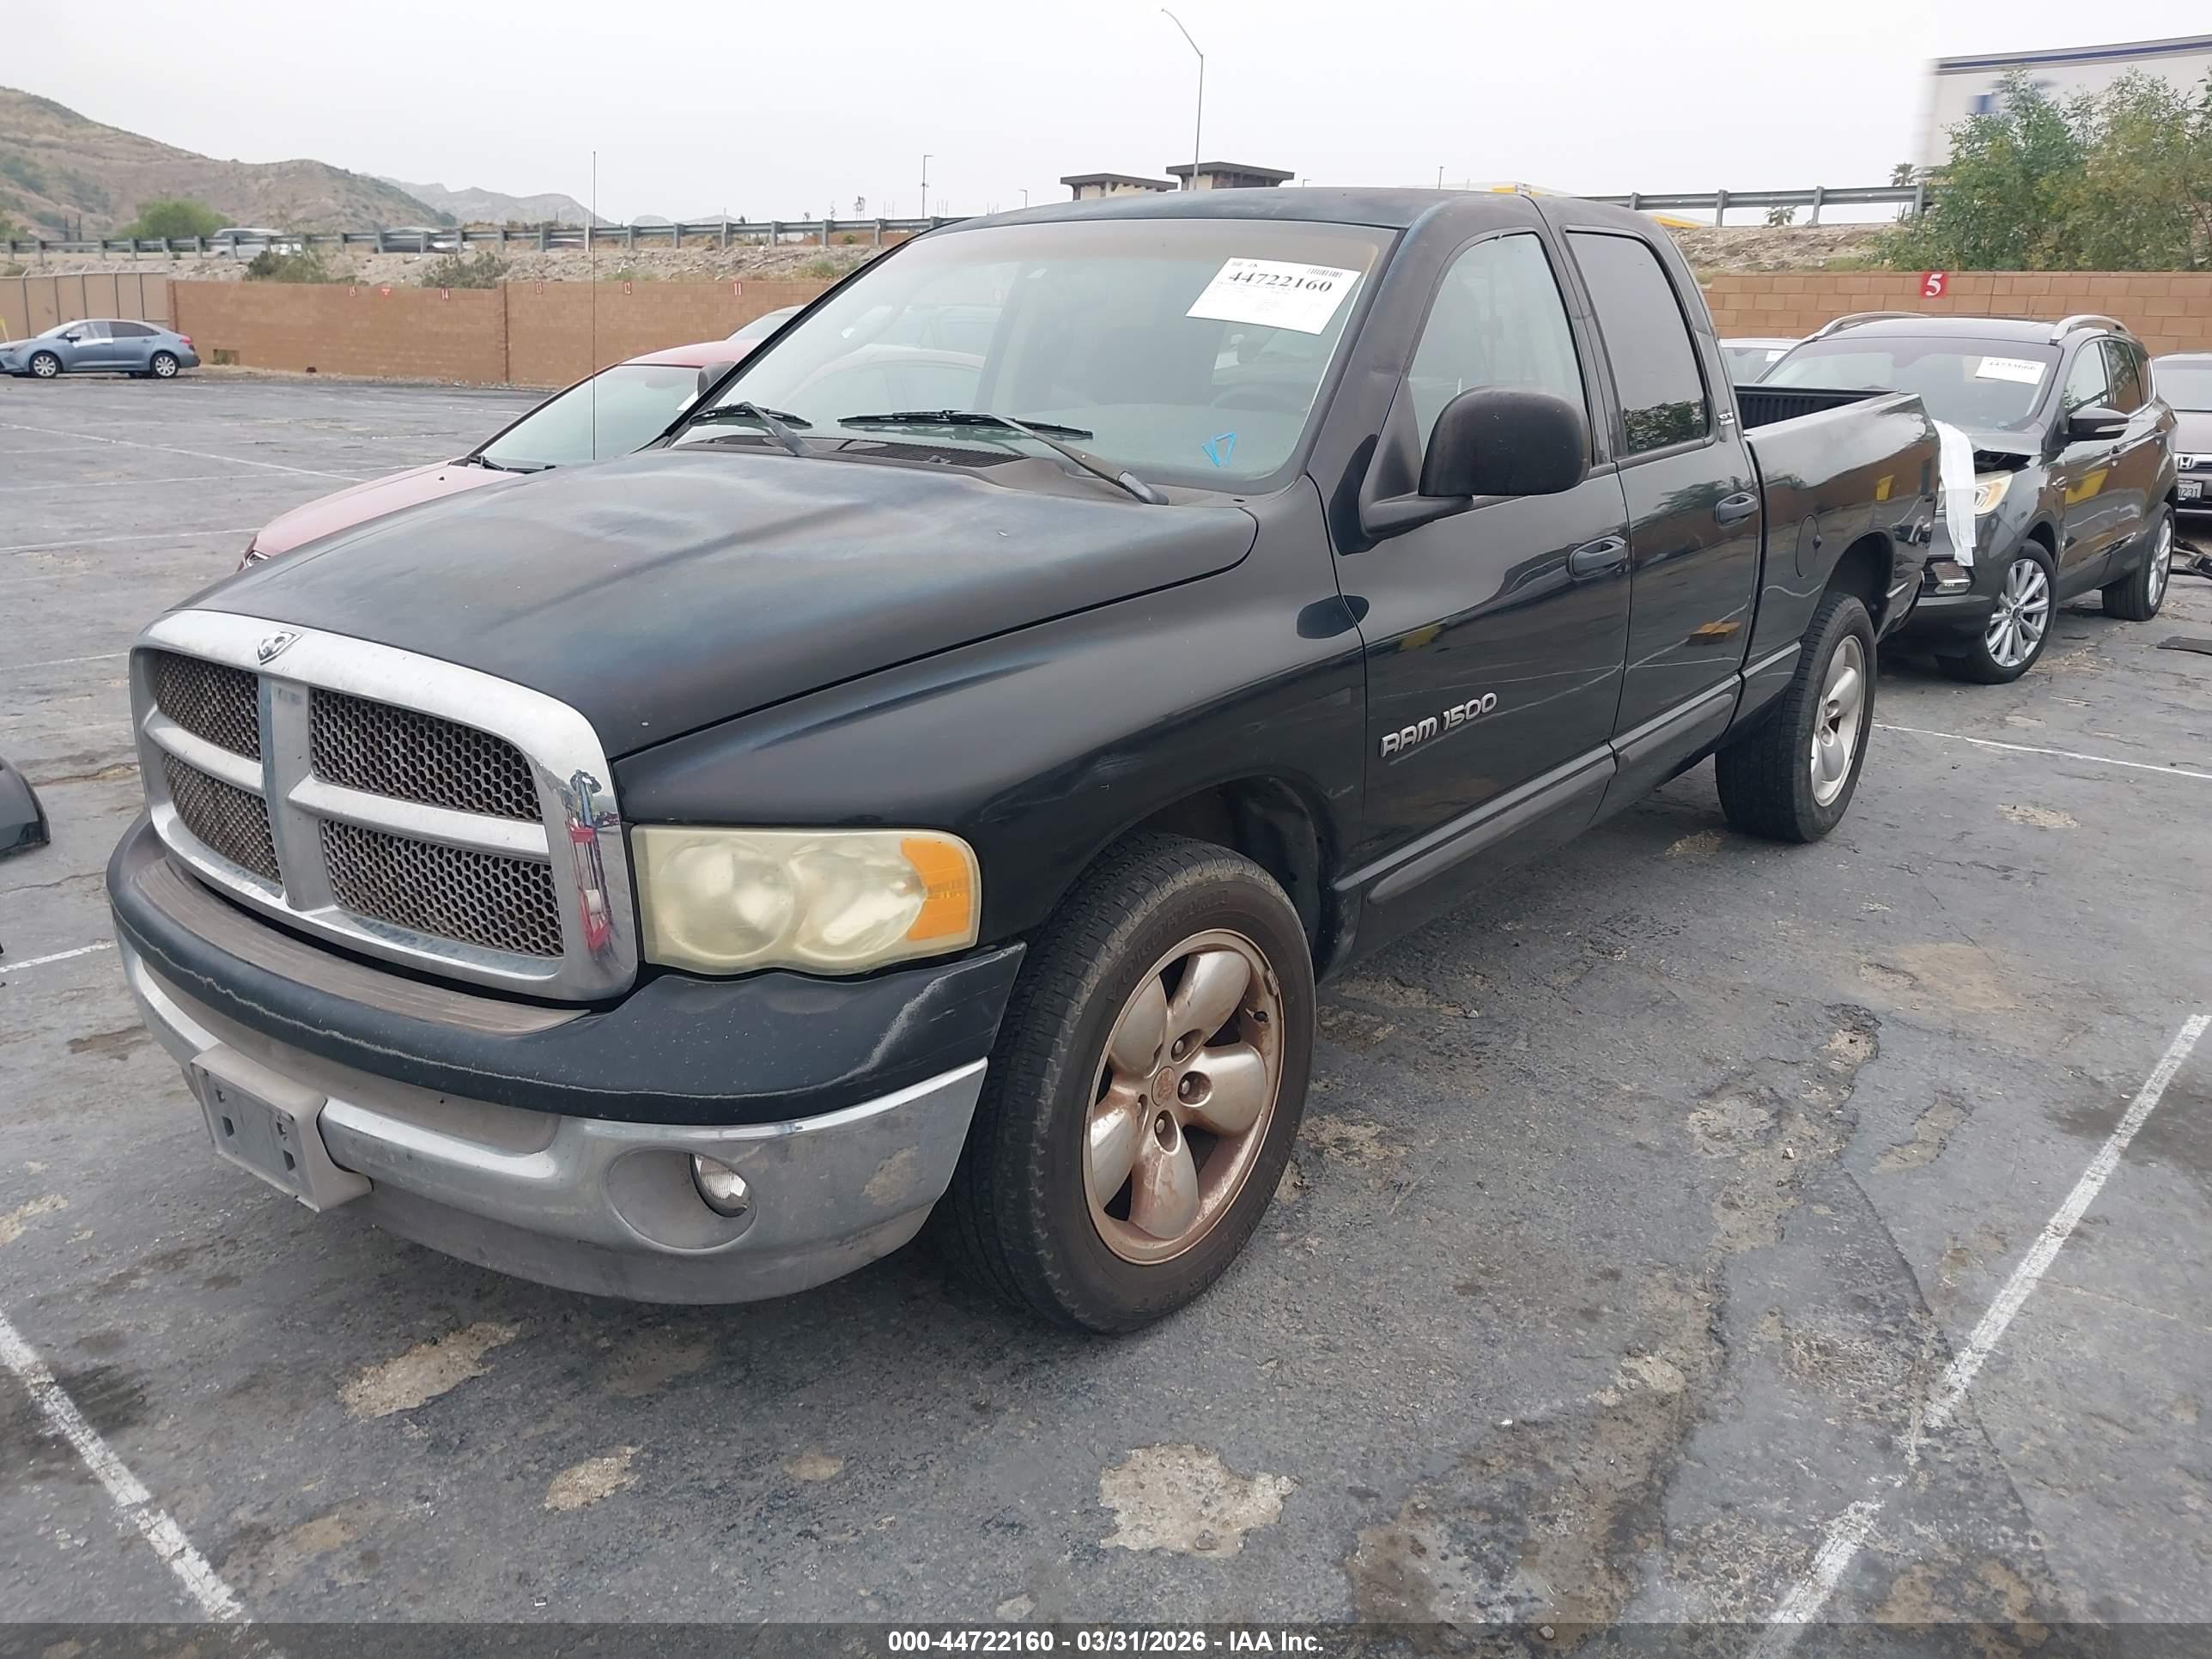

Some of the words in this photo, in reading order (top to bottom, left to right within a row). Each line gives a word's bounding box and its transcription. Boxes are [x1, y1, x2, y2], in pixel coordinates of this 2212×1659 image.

[1229, 270, 1333, 293] 44722160
[1925, 273, 1943, 296] 5
[1380, 716, 1437, 757] RAM
[1442, 692, 1497, 730] 1500
